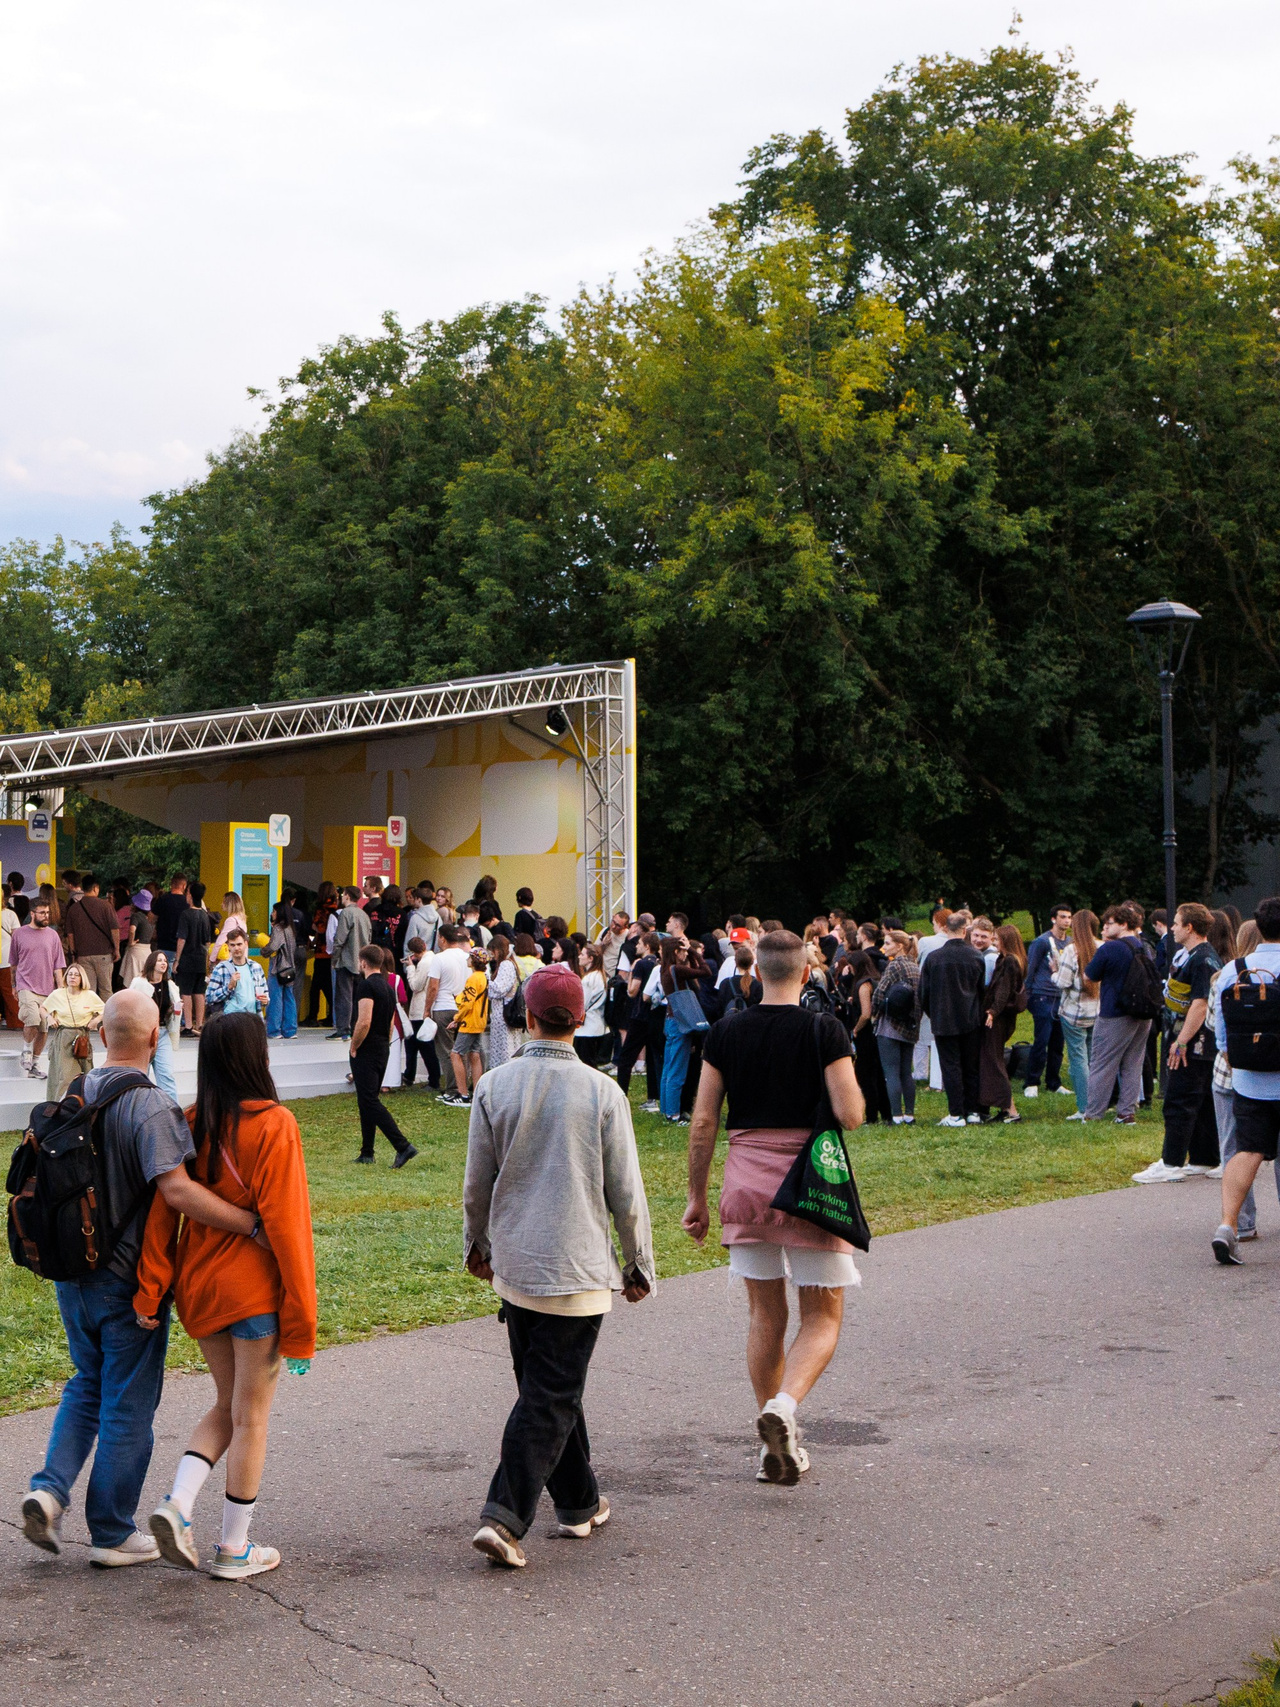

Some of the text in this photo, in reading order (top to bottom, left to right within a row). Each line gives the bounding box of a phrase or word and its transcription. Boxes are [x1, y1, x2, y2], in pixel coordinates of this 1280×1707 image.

[808, 1187, 848, 1211] Working
[798, 1201, 853, 1225] with nature
